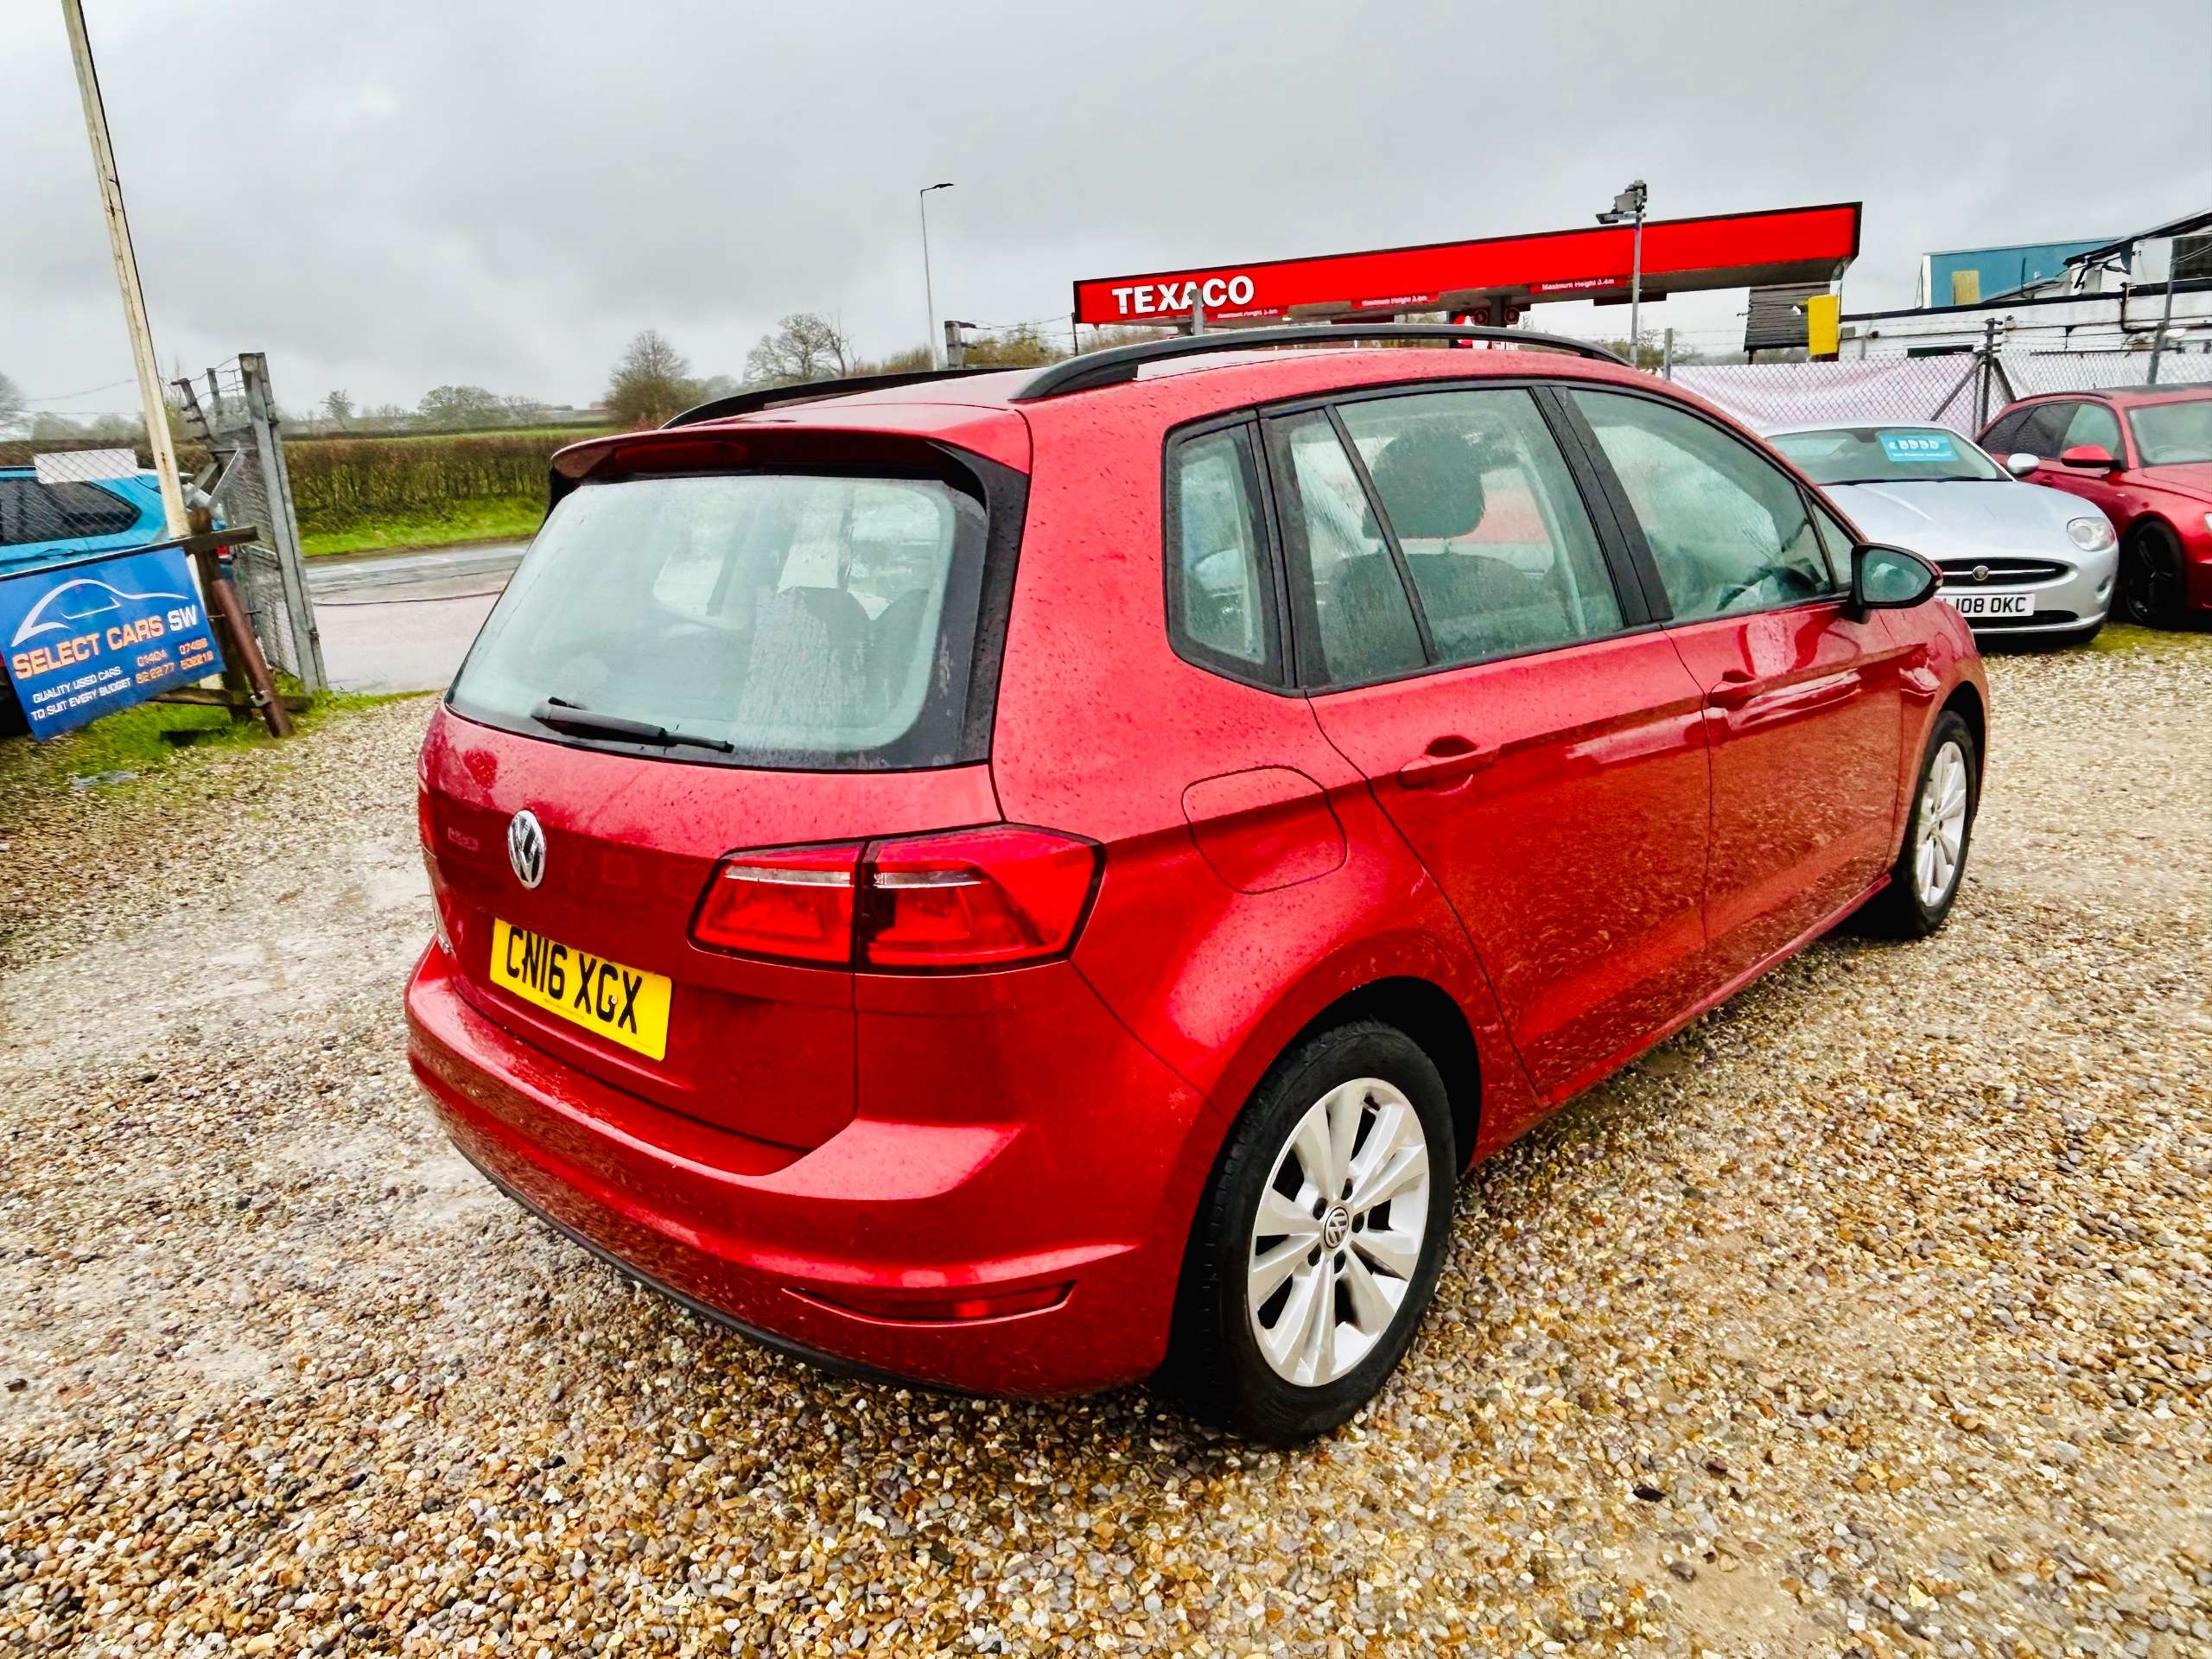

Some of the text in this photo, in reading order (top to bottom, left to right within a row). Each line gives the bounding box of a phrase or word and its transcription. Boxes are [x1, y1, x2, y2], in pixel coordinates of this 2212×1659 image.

[1111, 276, 1254, 315] TEXACO
[12, 605, 197, 680] SELECT CARS SW
[30, 708, 45, 721] TO
[46, 700, 67, 715] SUIT
[69, 690, 97, 708] EVERY
[33, 682, 70, 703] QUALITY
[73, 674, 97, 690] USED
[506, 925, 642, 1035] CN16 XGX
